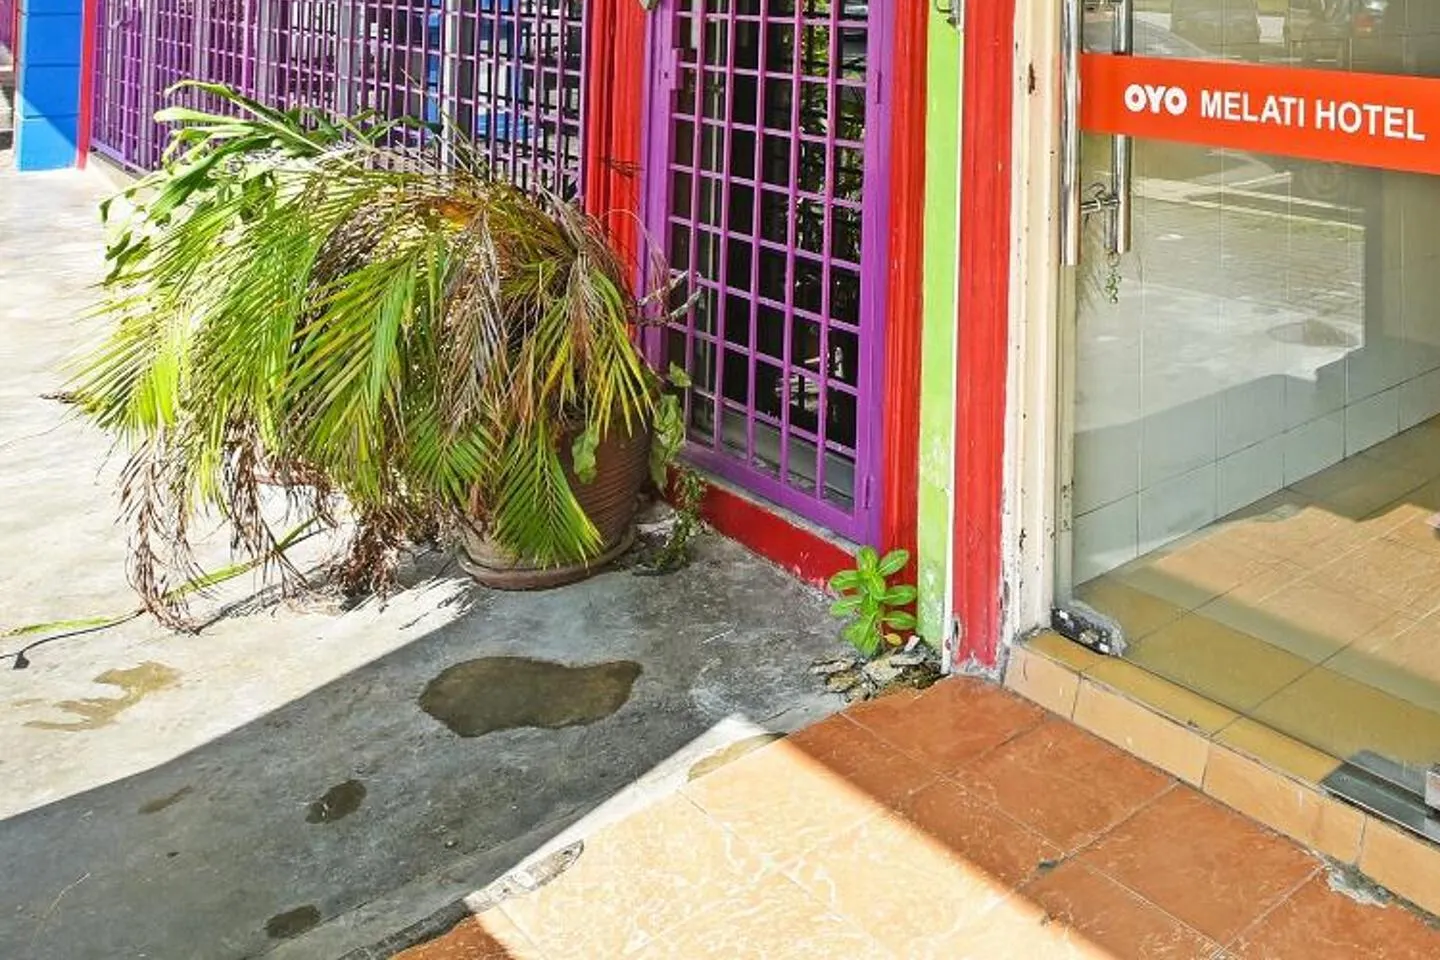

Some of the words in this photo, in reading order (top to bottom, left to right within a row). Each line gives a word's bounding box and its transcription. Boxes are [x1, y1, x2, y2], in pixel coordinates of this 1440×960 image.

[1124, 84, 1187, 115] OYO
[1200, 89, 1305, 127] MELATI
[1315, 99, 1425, 141] HOTEL
